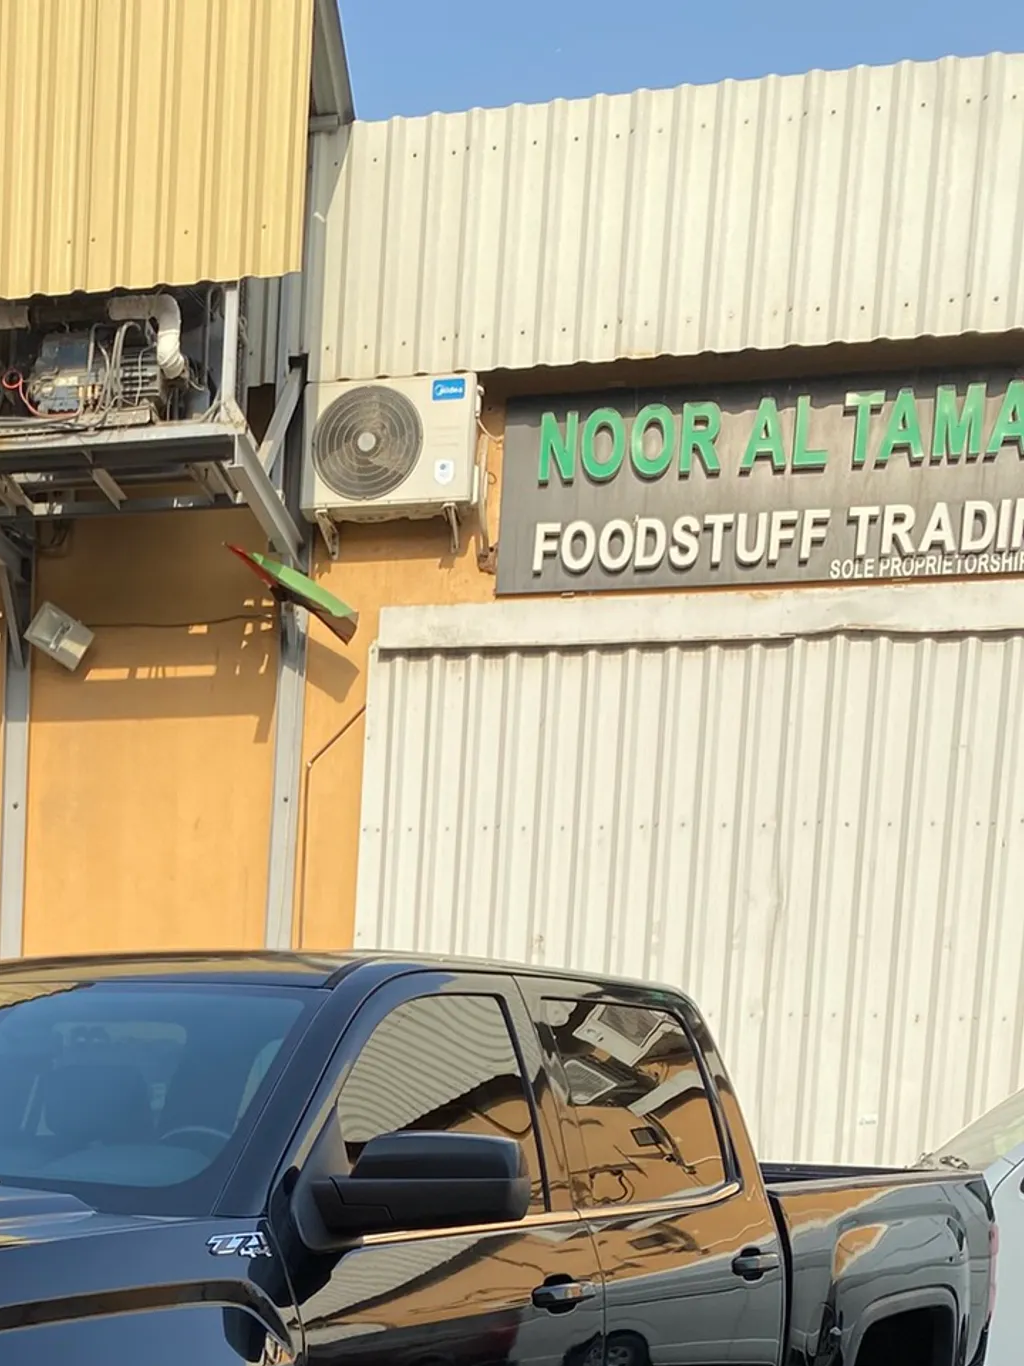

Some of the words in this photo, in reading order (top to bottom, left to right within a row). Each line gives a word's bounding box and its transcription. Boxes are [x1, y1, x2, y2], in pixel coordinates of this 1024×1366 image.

[538, 401, 721, 487] NOOR
[738, 395, 829, 476] AL
[532, 509, 831, 576] FOODSTUFF
[829, 558, 875, 579] SOLE
